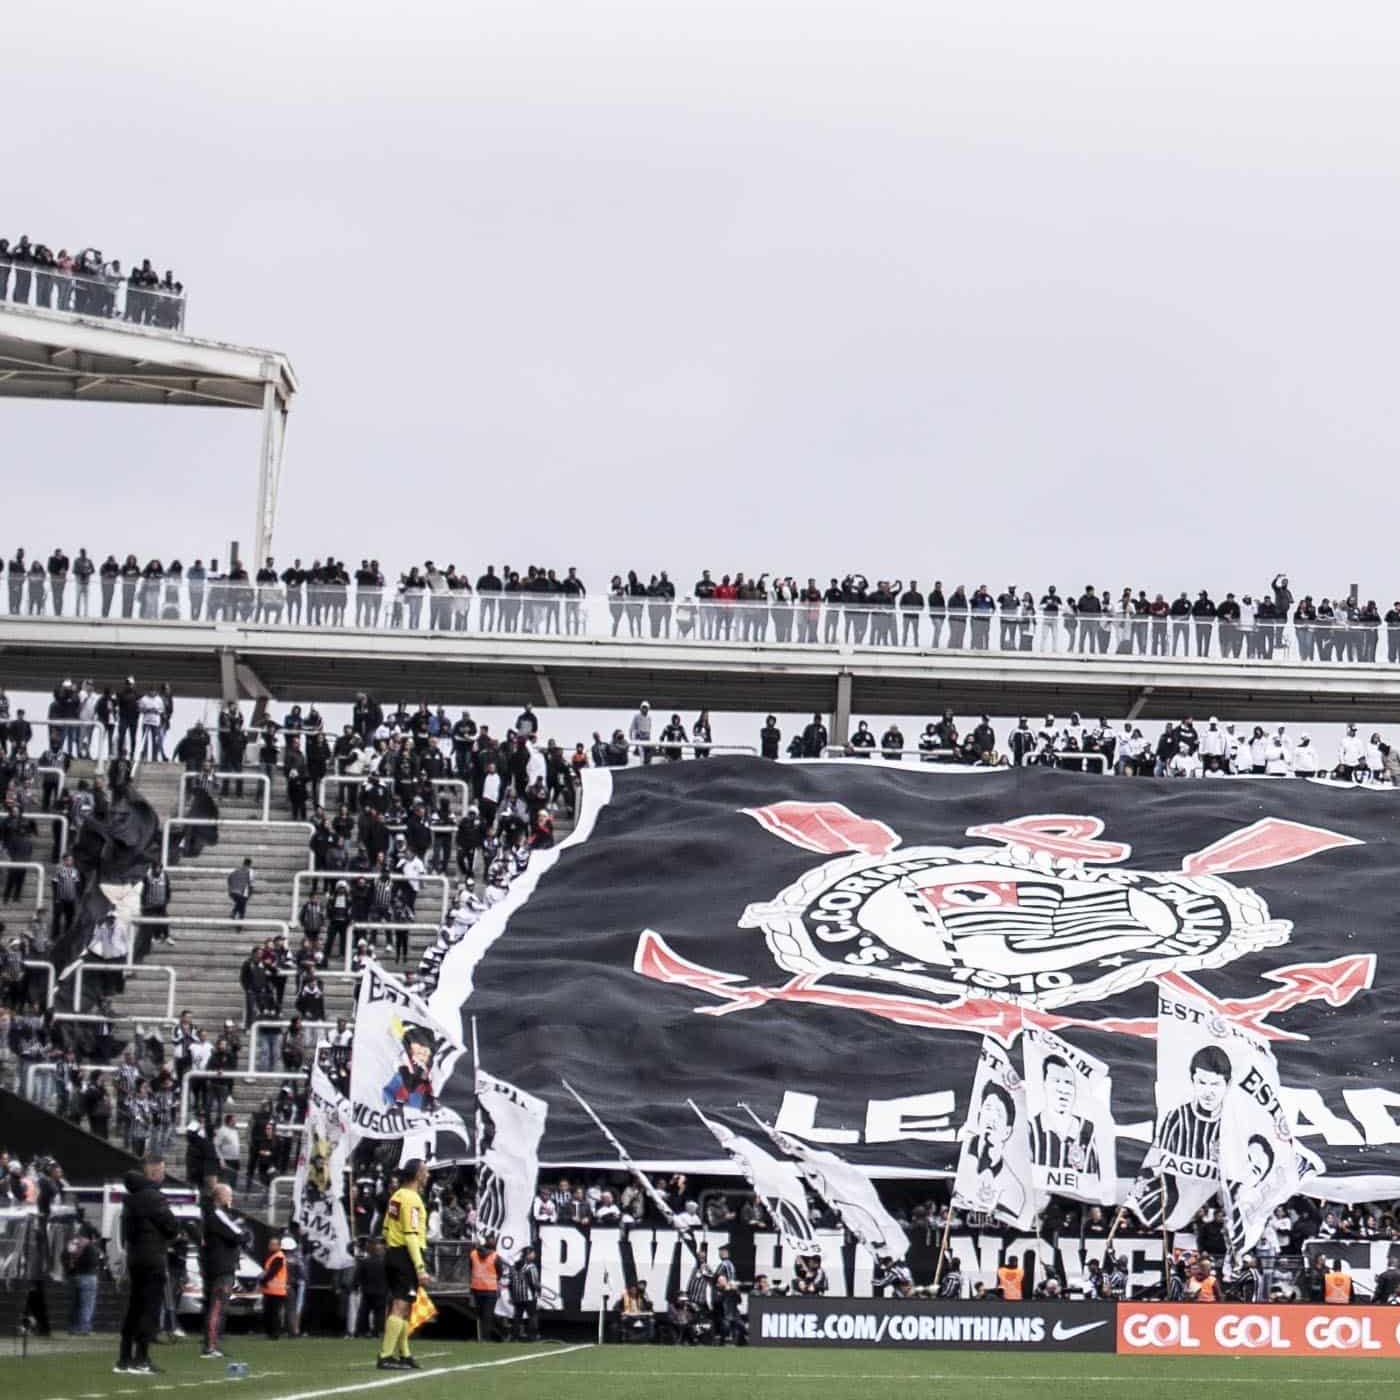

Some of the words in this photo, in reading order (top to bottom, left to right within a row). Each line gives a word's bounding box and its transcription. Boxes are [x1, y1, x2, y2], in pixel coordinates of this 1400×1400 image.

[951, 966, 1074, 994] 1910
[761, 1312, 1045, 1342] NIKE.COM/CORINTHIANS
[1123, 1313, 1200, 1348] GOL
[1214, 1314, 1291, 1348] GOL
[1305, 1316, 1382, 1350] GOL
